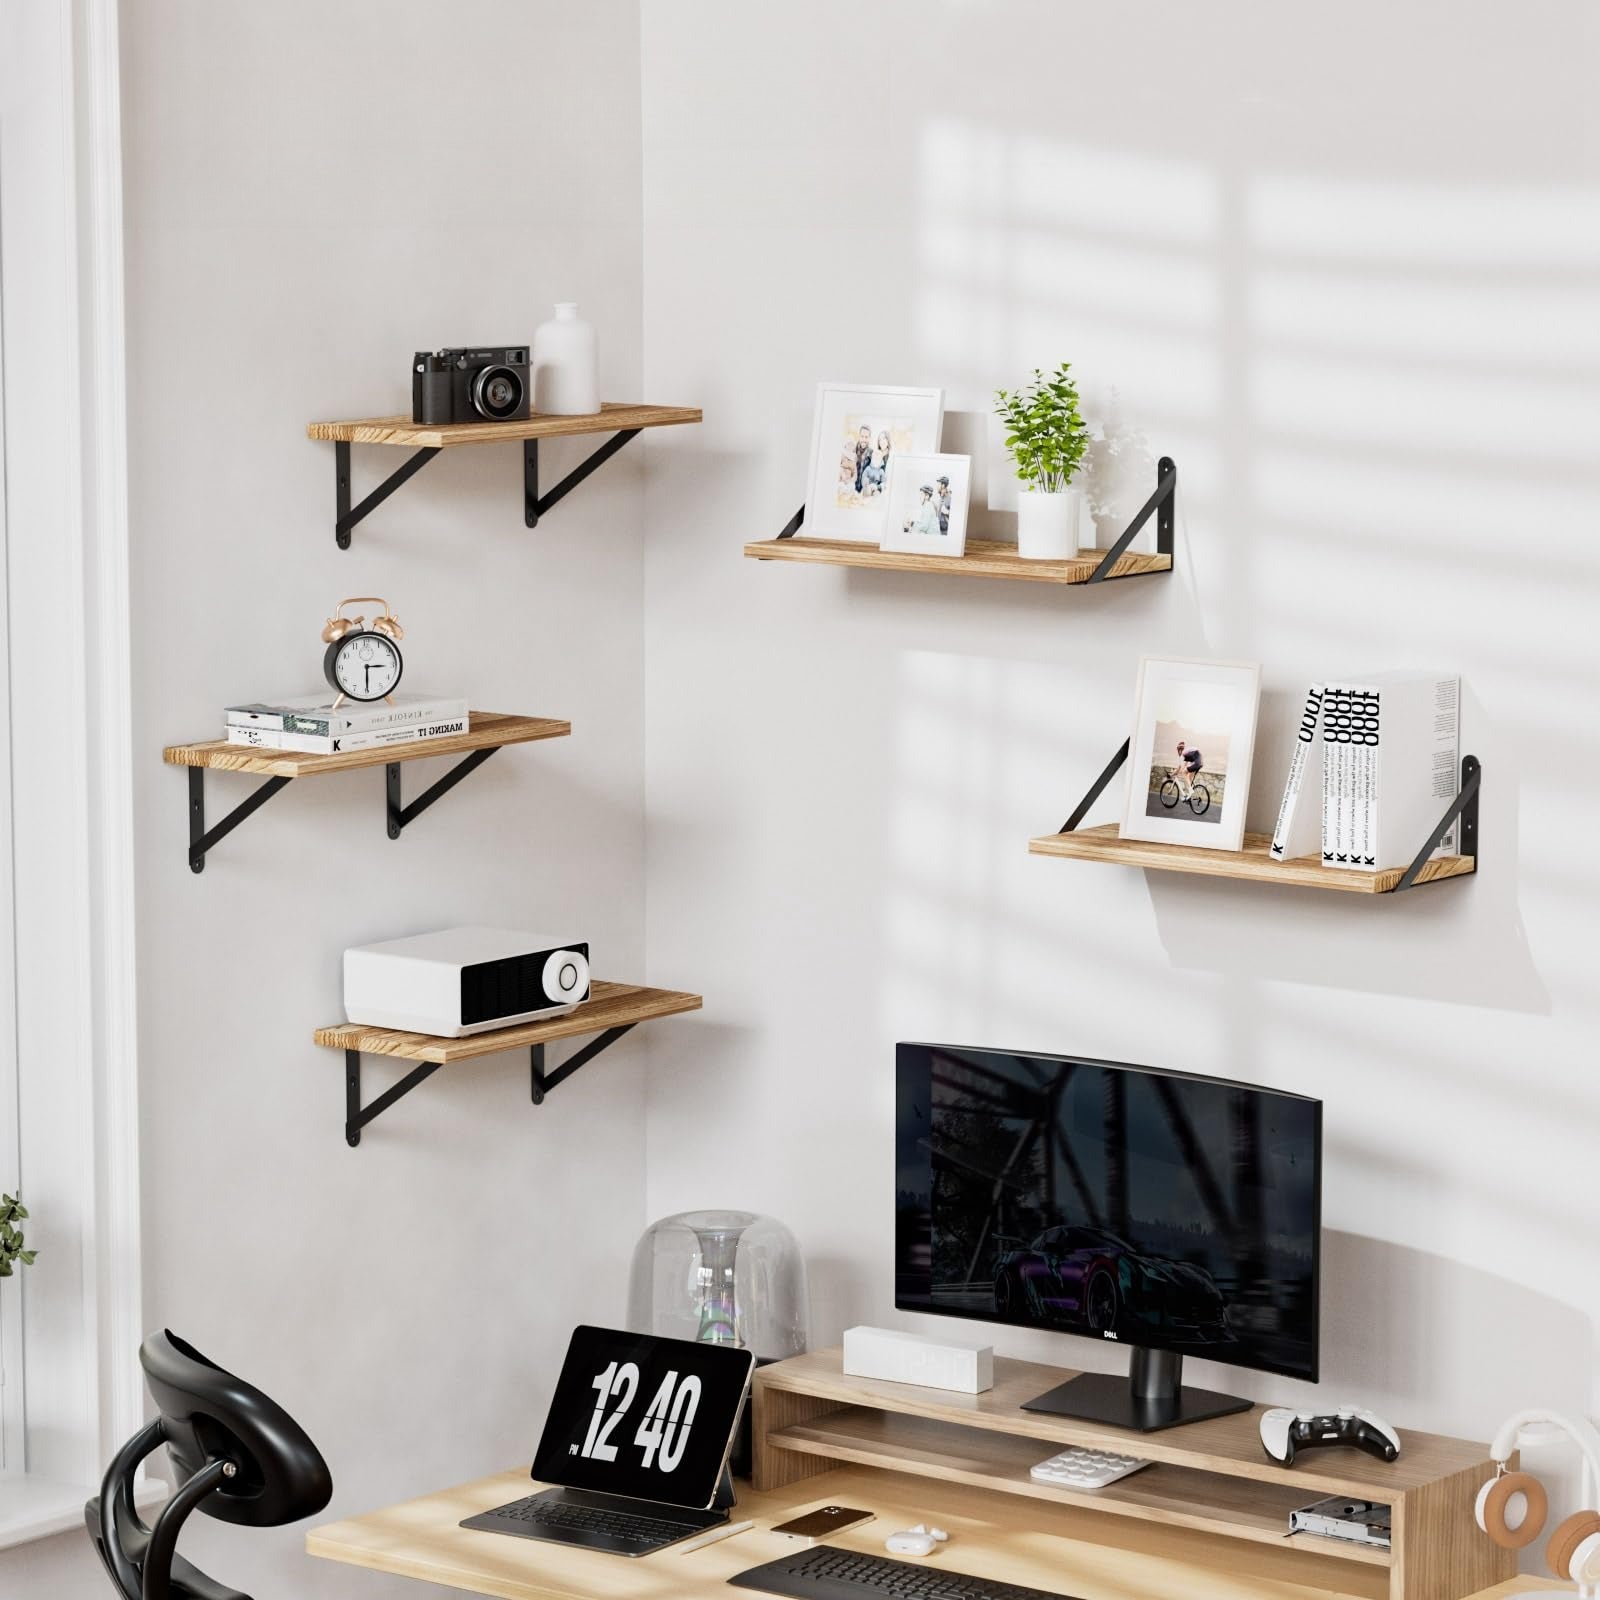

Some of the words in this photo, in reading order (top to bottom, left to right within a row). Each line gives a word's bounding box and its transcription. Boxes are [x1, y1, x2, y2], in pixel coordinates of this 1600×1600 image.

[332, 739, 342, 752] K
[1272, 842, 1284, 854] K
[1323, 851, 1334, 861] K
[1336, 853, 1347, 863] K
[1350, 855, 1361, 864] K
[1364, 856, 1375, 865] K
[1104, 1330, 1118, 1340] DELL
[580, 1361, 640, 1462] 12
[633, 1370, 702, 1473] 40
[568, 1443, 579, 1456] PM
